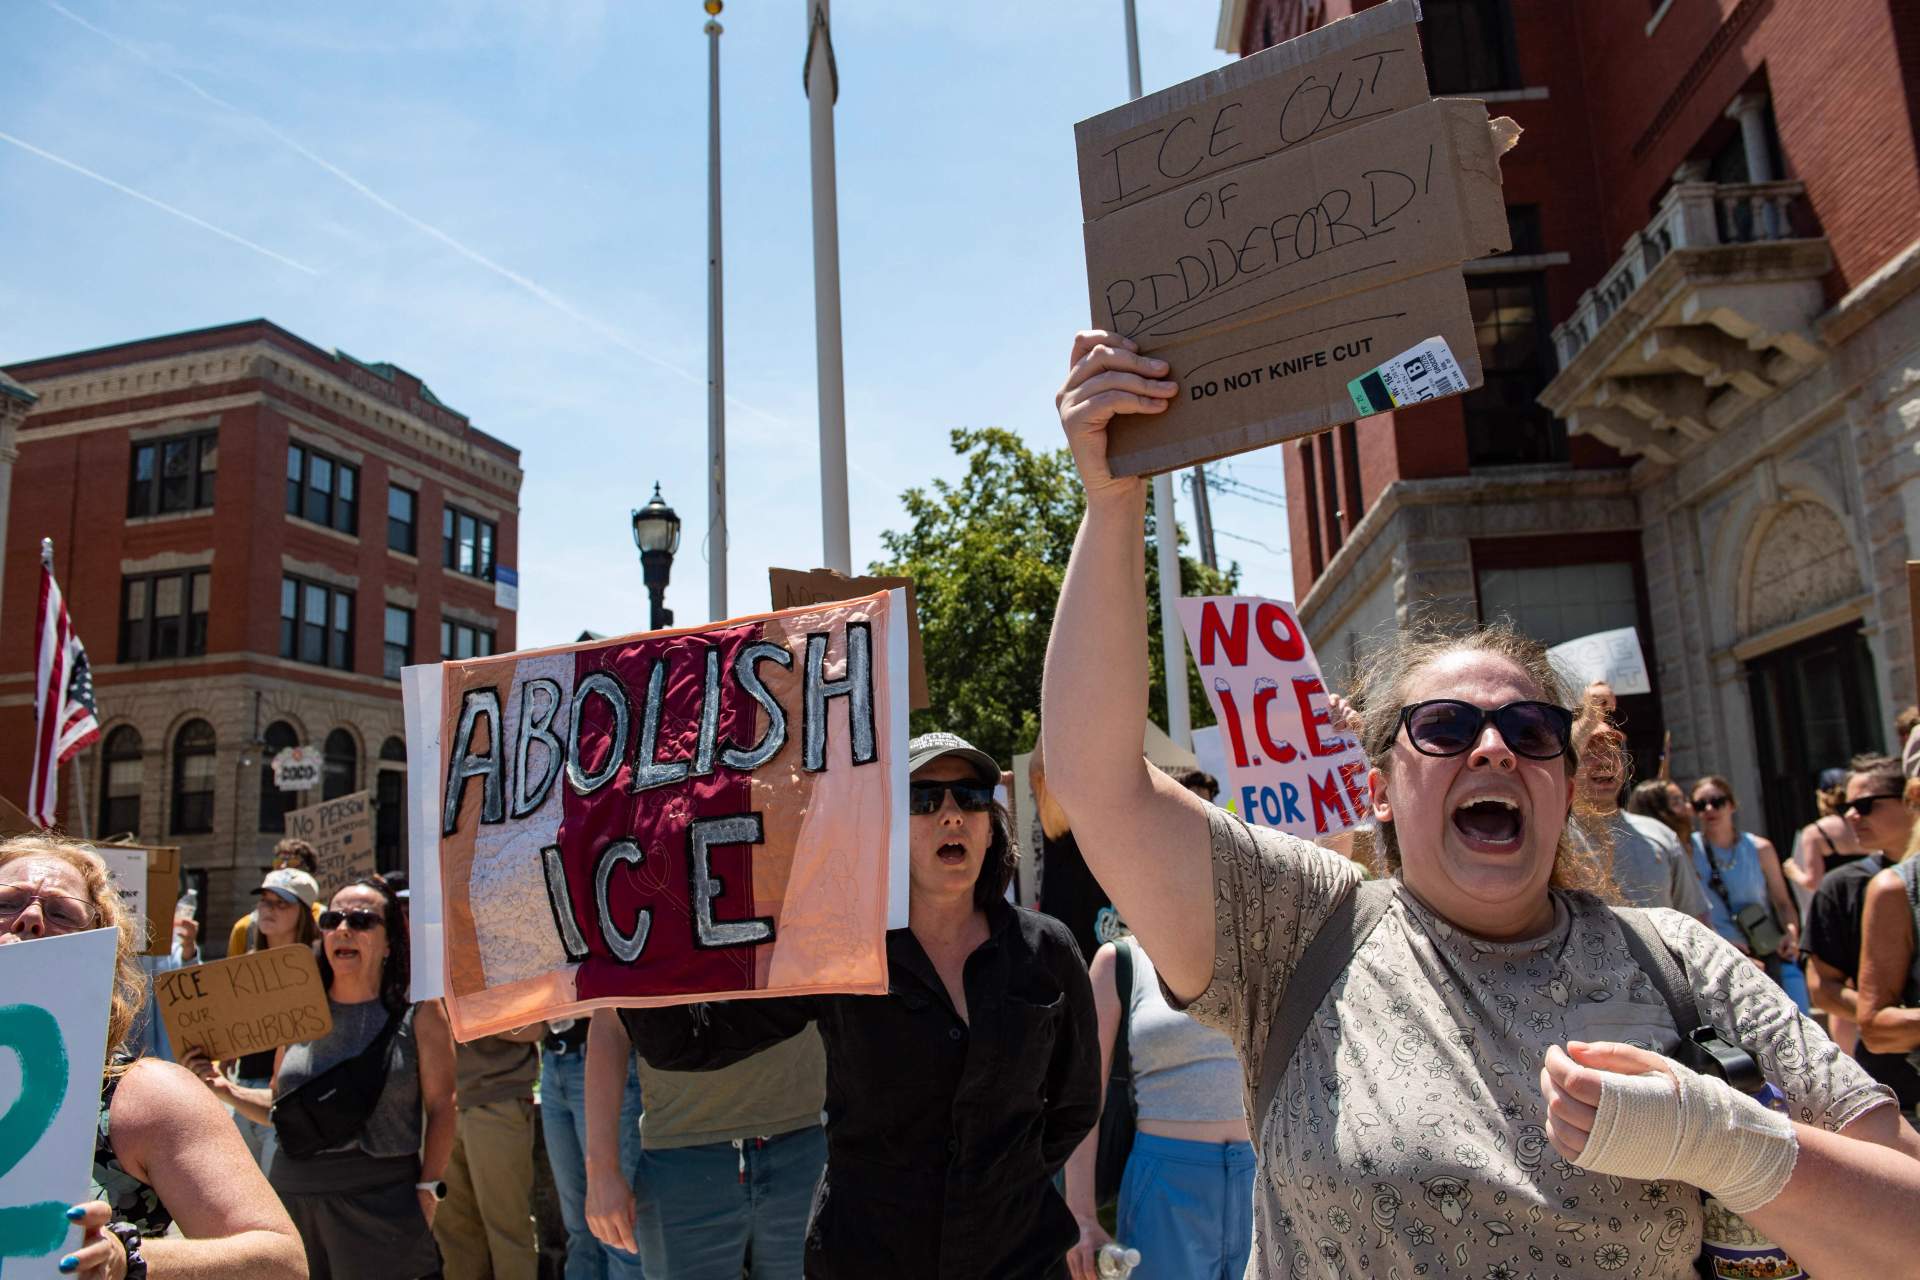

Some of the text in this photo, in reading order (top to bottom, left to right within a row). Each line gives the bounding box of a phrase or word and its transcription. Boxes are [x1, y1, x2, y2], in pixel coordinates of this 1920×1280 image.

[1101, 49, 1405, 205] ICE OUT
[1184, 182, 1239, 229] OF
[1190, 337, 1374, 401] DO NOT KNIFE CUT
[1425, 350, 1442, 375] GROCERY
[1200, 601, 1305, 667] NO
[442, 621, 878, 838] ABOLISH
[1241, 782, 1306, 826] FOR
[318, 841, 340, 857] IFE
[541, 811, 777, 965] ICE
[160, 952, 310, 1007] ICE KILLS
[178, 1007, 215, 1028] OUR
[181, 1004, 326, 1057] NEIGHBORS
